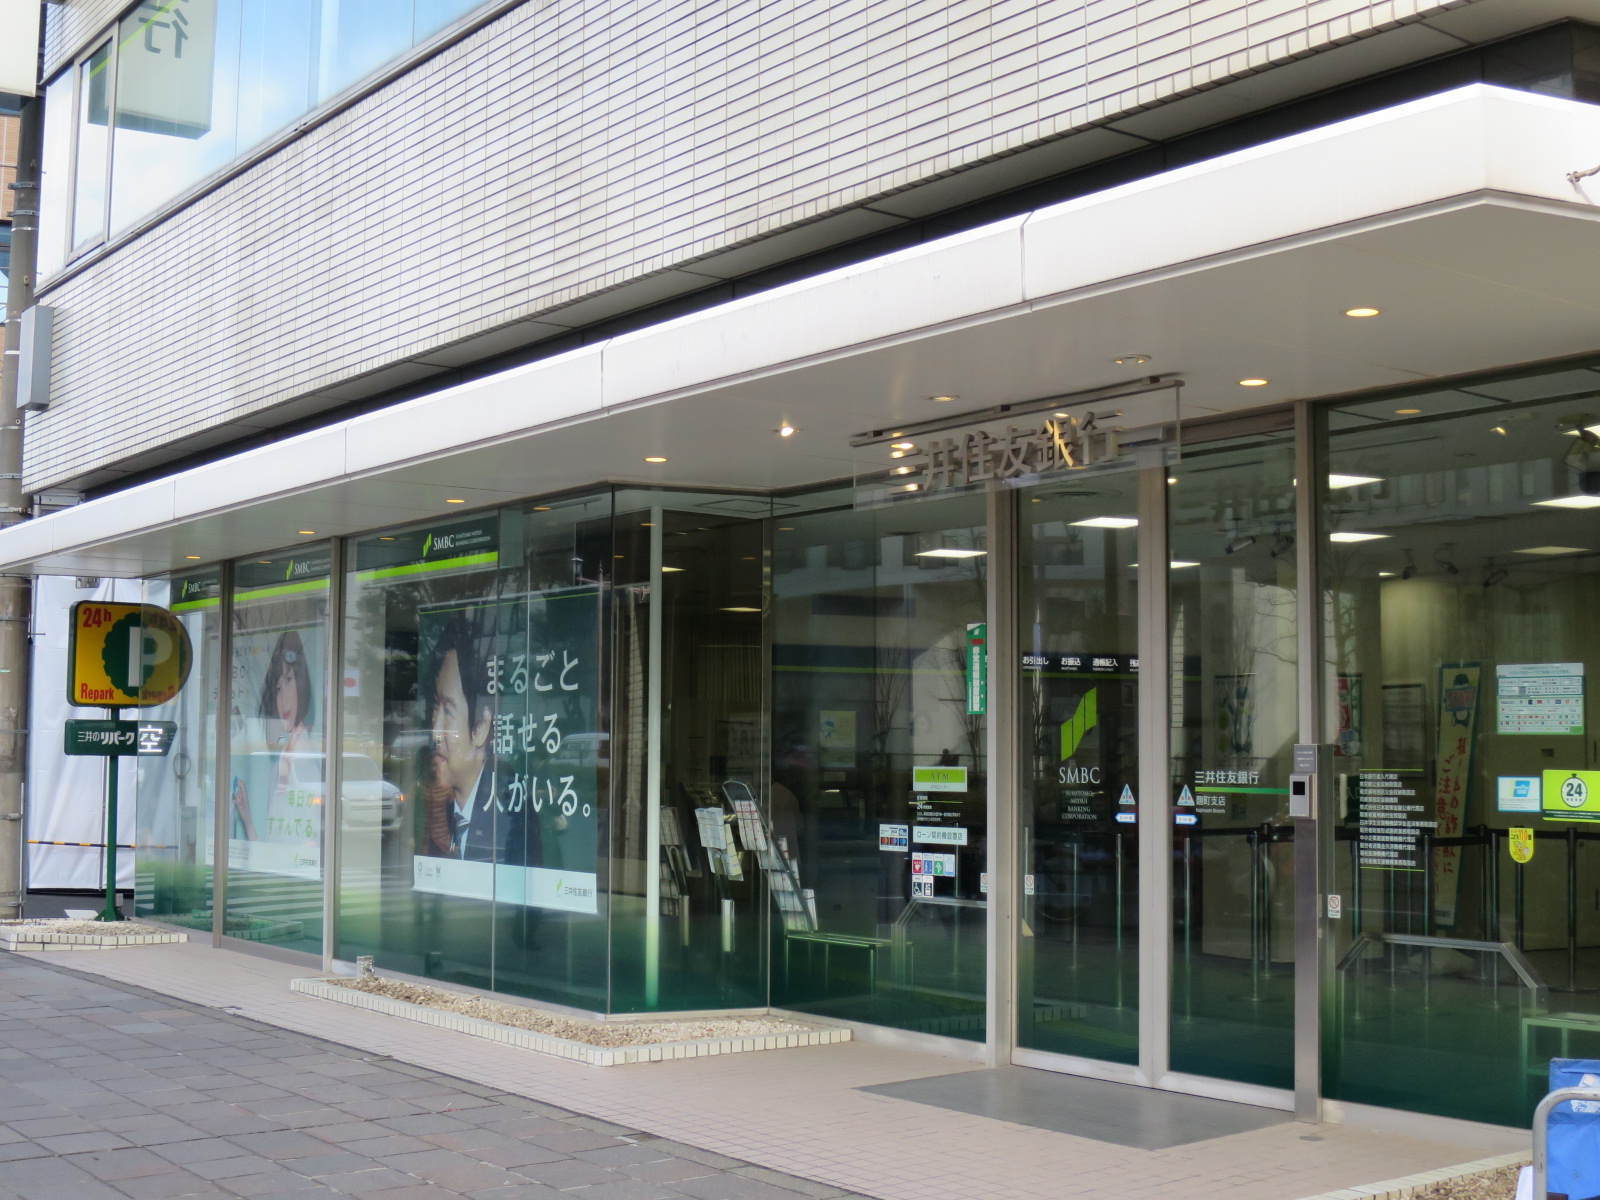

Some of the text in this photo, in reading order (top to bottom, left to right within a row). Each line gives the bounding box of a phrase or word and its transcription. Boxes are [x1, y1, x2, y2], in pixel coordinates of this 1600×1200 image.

[889, 410, 1123, 491] 三井住友銀行
[434, 534, 454, 550] SMBC
[294, 559, 311, 574] SMBC
[188, 582, 201, 593] SMBC
[1022, 656, 1049, 665] お引出し
[486, 650, 579, 695] まるごと
[80, 682, 114, 702] Repark
[78, 725, 163, 752] 三井のリパーク 空
[492, 713, 561, 754] 話せる
[930, 772, 950, 780] ATM
[1058, 766, 1100, 784] SMBC
[1194, 770, 1260, 785] 三井住友銀行
[483, 772, 591, 818] 人がいる。
[1566, 782, 1583, 796] 24
[916, 831, 963, 841] ローン契約機設置店
[564, 886, 593, 898] 三井住友銀行
